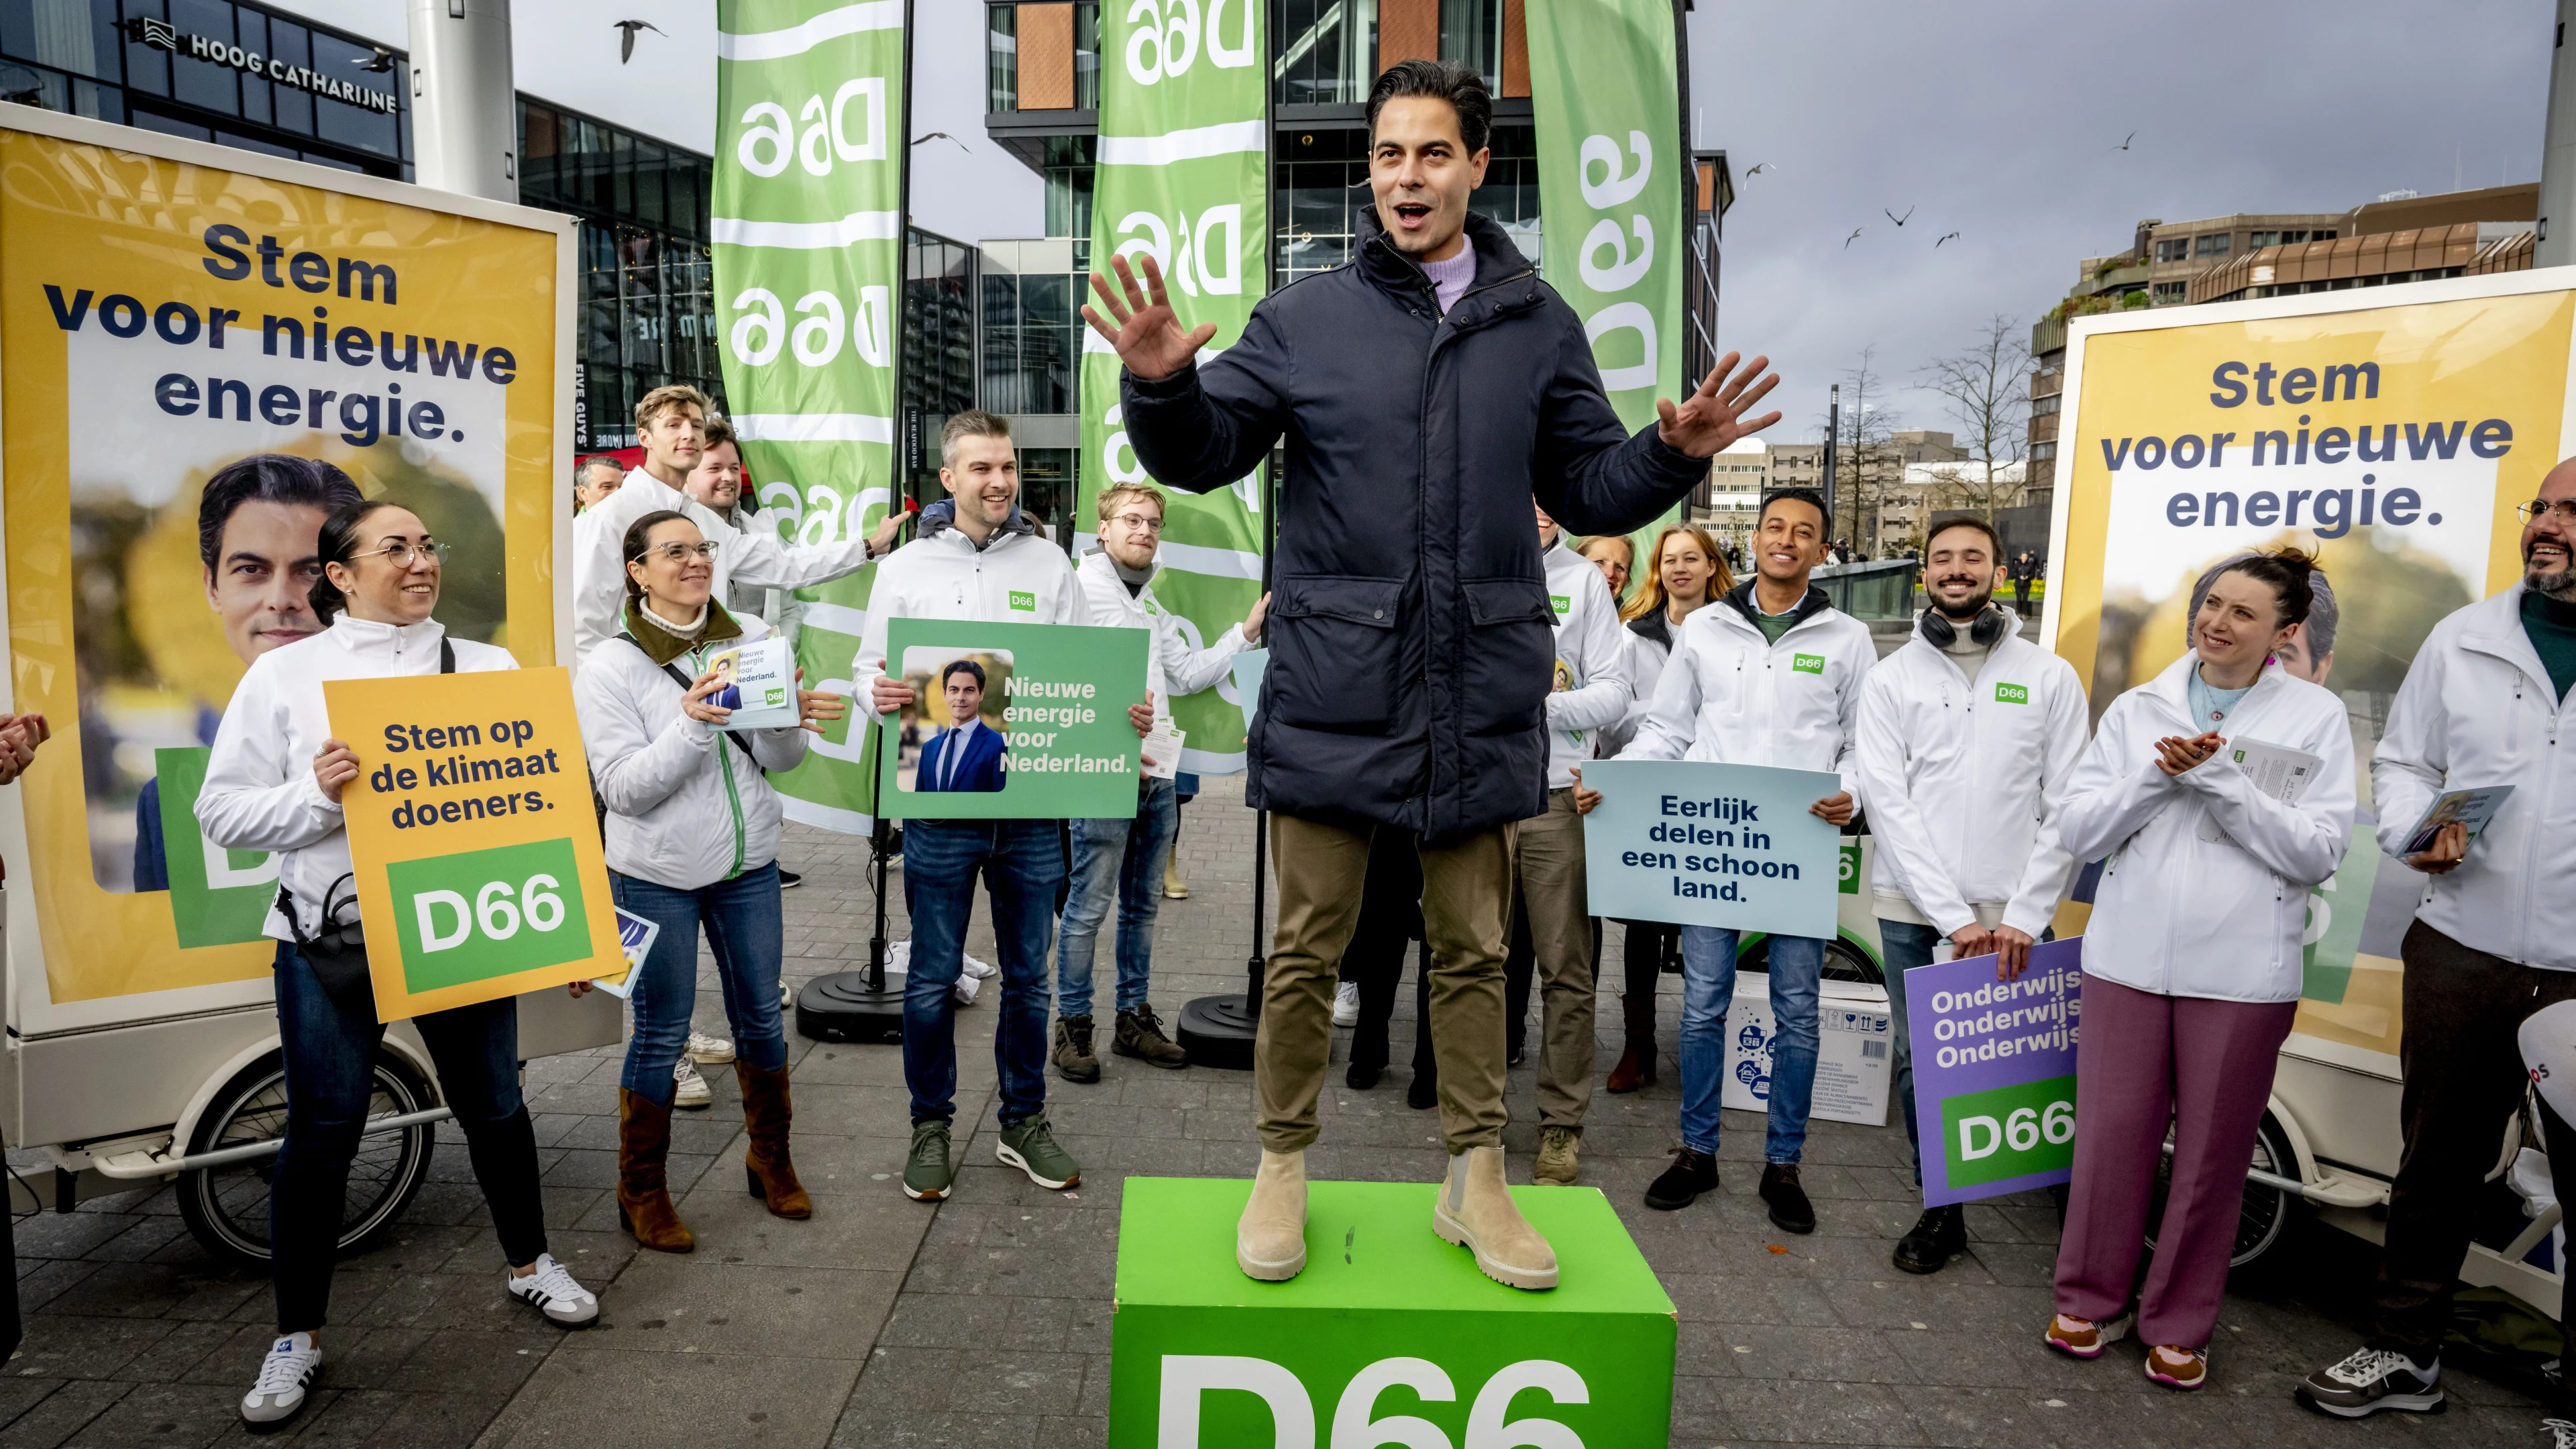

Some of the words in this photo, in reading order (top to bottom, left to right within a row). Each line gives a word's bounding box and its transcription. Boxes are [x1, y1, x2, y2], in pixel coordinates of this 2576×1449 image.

[191, 34, 263, 72] HOOG
[270, 59, 396, 114] CATHARIJNE
[203, 224, 397, 305] Stem
[42, 284, 240, 350] voor
[262, 306, 517, 384] nieuwe
[576, 364, 584, 398] FIVE
[2210, 360, 2380, 409] Stem
[155, 370, 465, 447] energie.
[576, 403, 587, 445] GUYS
[2100, 432, 2235, 472] voor
[2251, 415, 2514, 466] nieuwe
[2165, 474, 2443, 539] energie.
[1012, 596, 1032, 606] D66
[1550, 600, 1567, 609] 66
[738, 657, 764, 666] energie
[739, 649, 764, 659] Nieuwe
[1796, 658, 1821, 669] D66
[737, 672, 777, 684] Nederland.
[1004, 677, 1095, 698] Nieuwe
[767, 692, 784, 701] D66
[1999, 688, 2025, 699] D66
[1003, 703, 1095, 728] energie
[384, 723, 481, 753] Stem
[488, 719, 535, 748] op
[1002, 731, 1057, 747] voor
[370, 762, 418, 794] de
[425, 748, 561, 787] klimaat
[1000, 753, 1131, 773] Nederland.
[2235, 751, 2243, 762] D66
[391, 792, 555, 830] doeners.
[1660, 795, 1758, 825] Eerlijk
[1650, 822, 1734, 847] delen
[1743, 825, 1770, 850] in
[1621, 851, 1677, 870] een
[1684, 853, 1799, 881] schoon
[1673, 876, 1747, 902] land.
[413, 873, 566, 954] D66
[1931, 967, 2081, 1014] Onderwijs
[1933, 996, 2081, 1042] Onderwijs
[1959, 1099, 2076, 1161] D66
